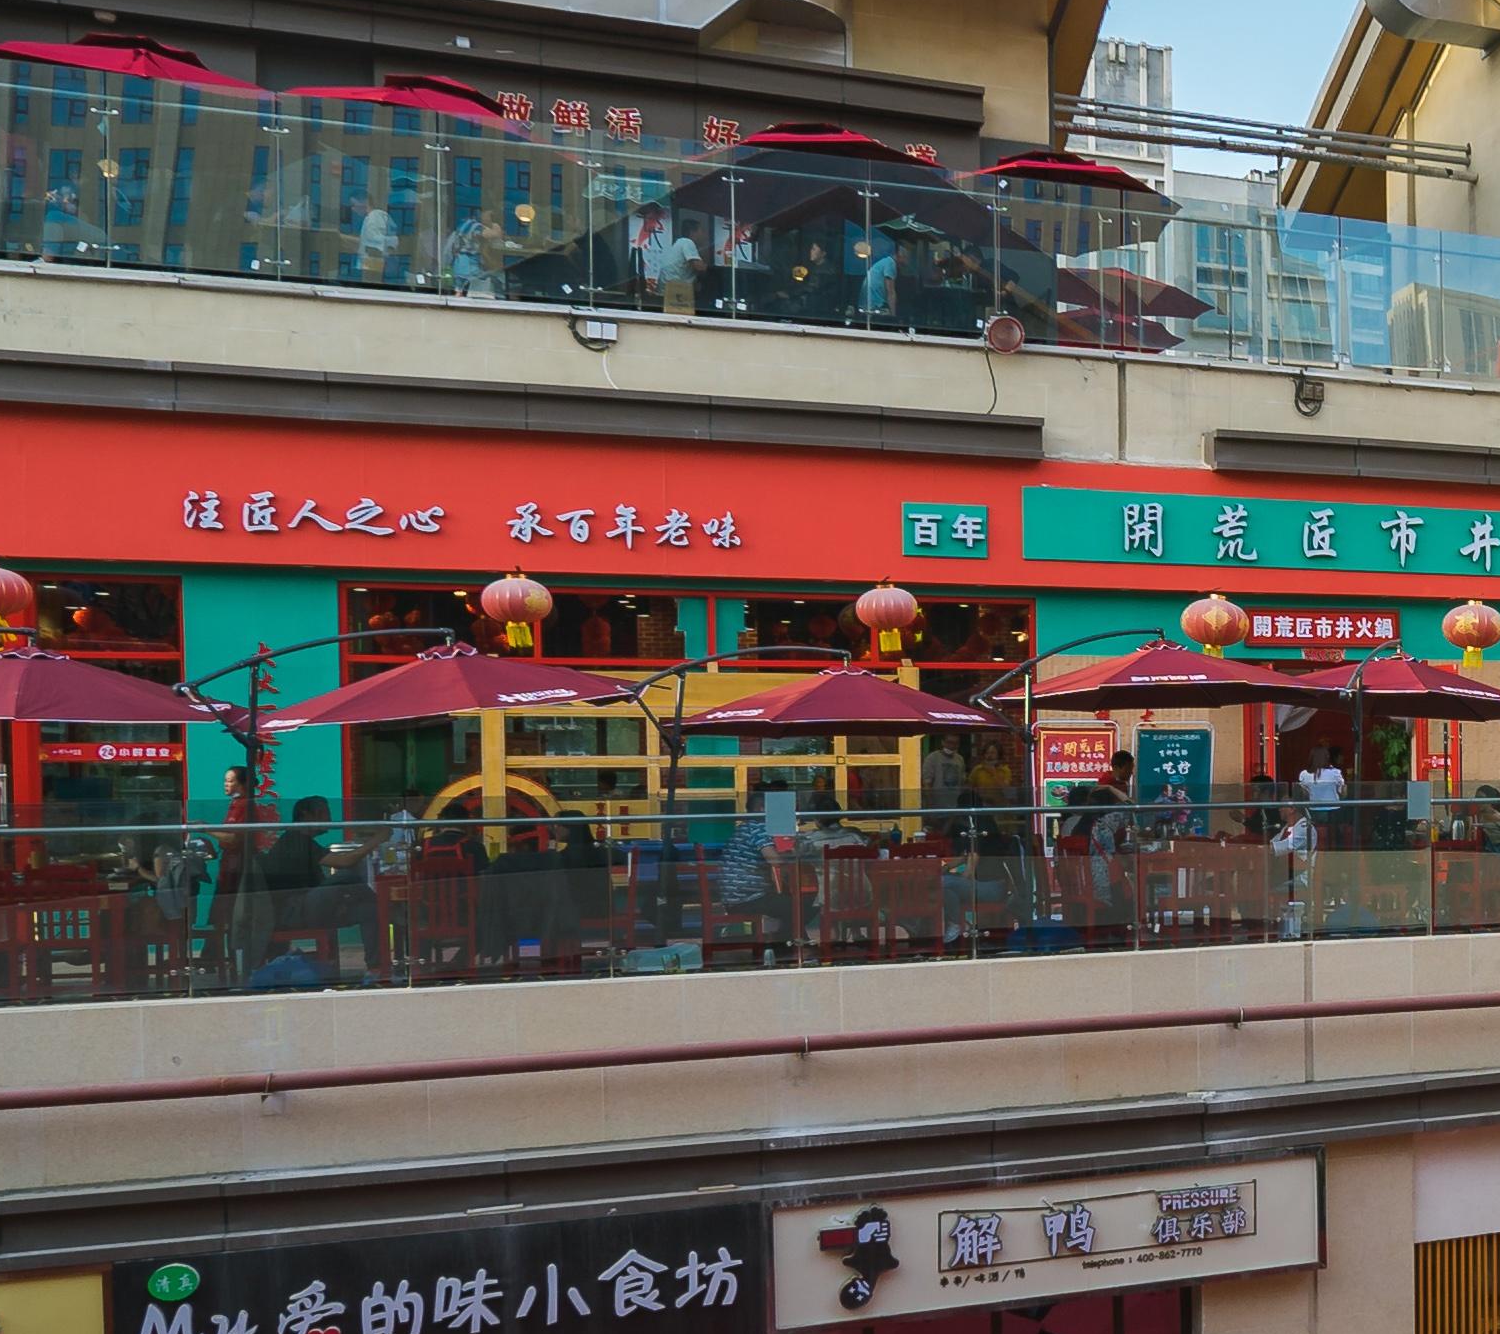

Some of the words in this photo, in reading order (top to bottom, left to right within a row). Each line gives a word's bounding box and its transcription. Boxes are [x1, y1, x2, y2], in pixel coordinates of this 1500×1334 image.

[506, 502, 742, 550] 承百年老味
[908, 511, 987, 549] 百年
[1252, 615, 1395, 640] 開荒匠市井火鍋
[1160, 1184, 1239, 1213] PRESSURE
[949, 1204, 1096, 1267] 解鸭
[1152, 1208, 1247, 1245] 俱乐部
